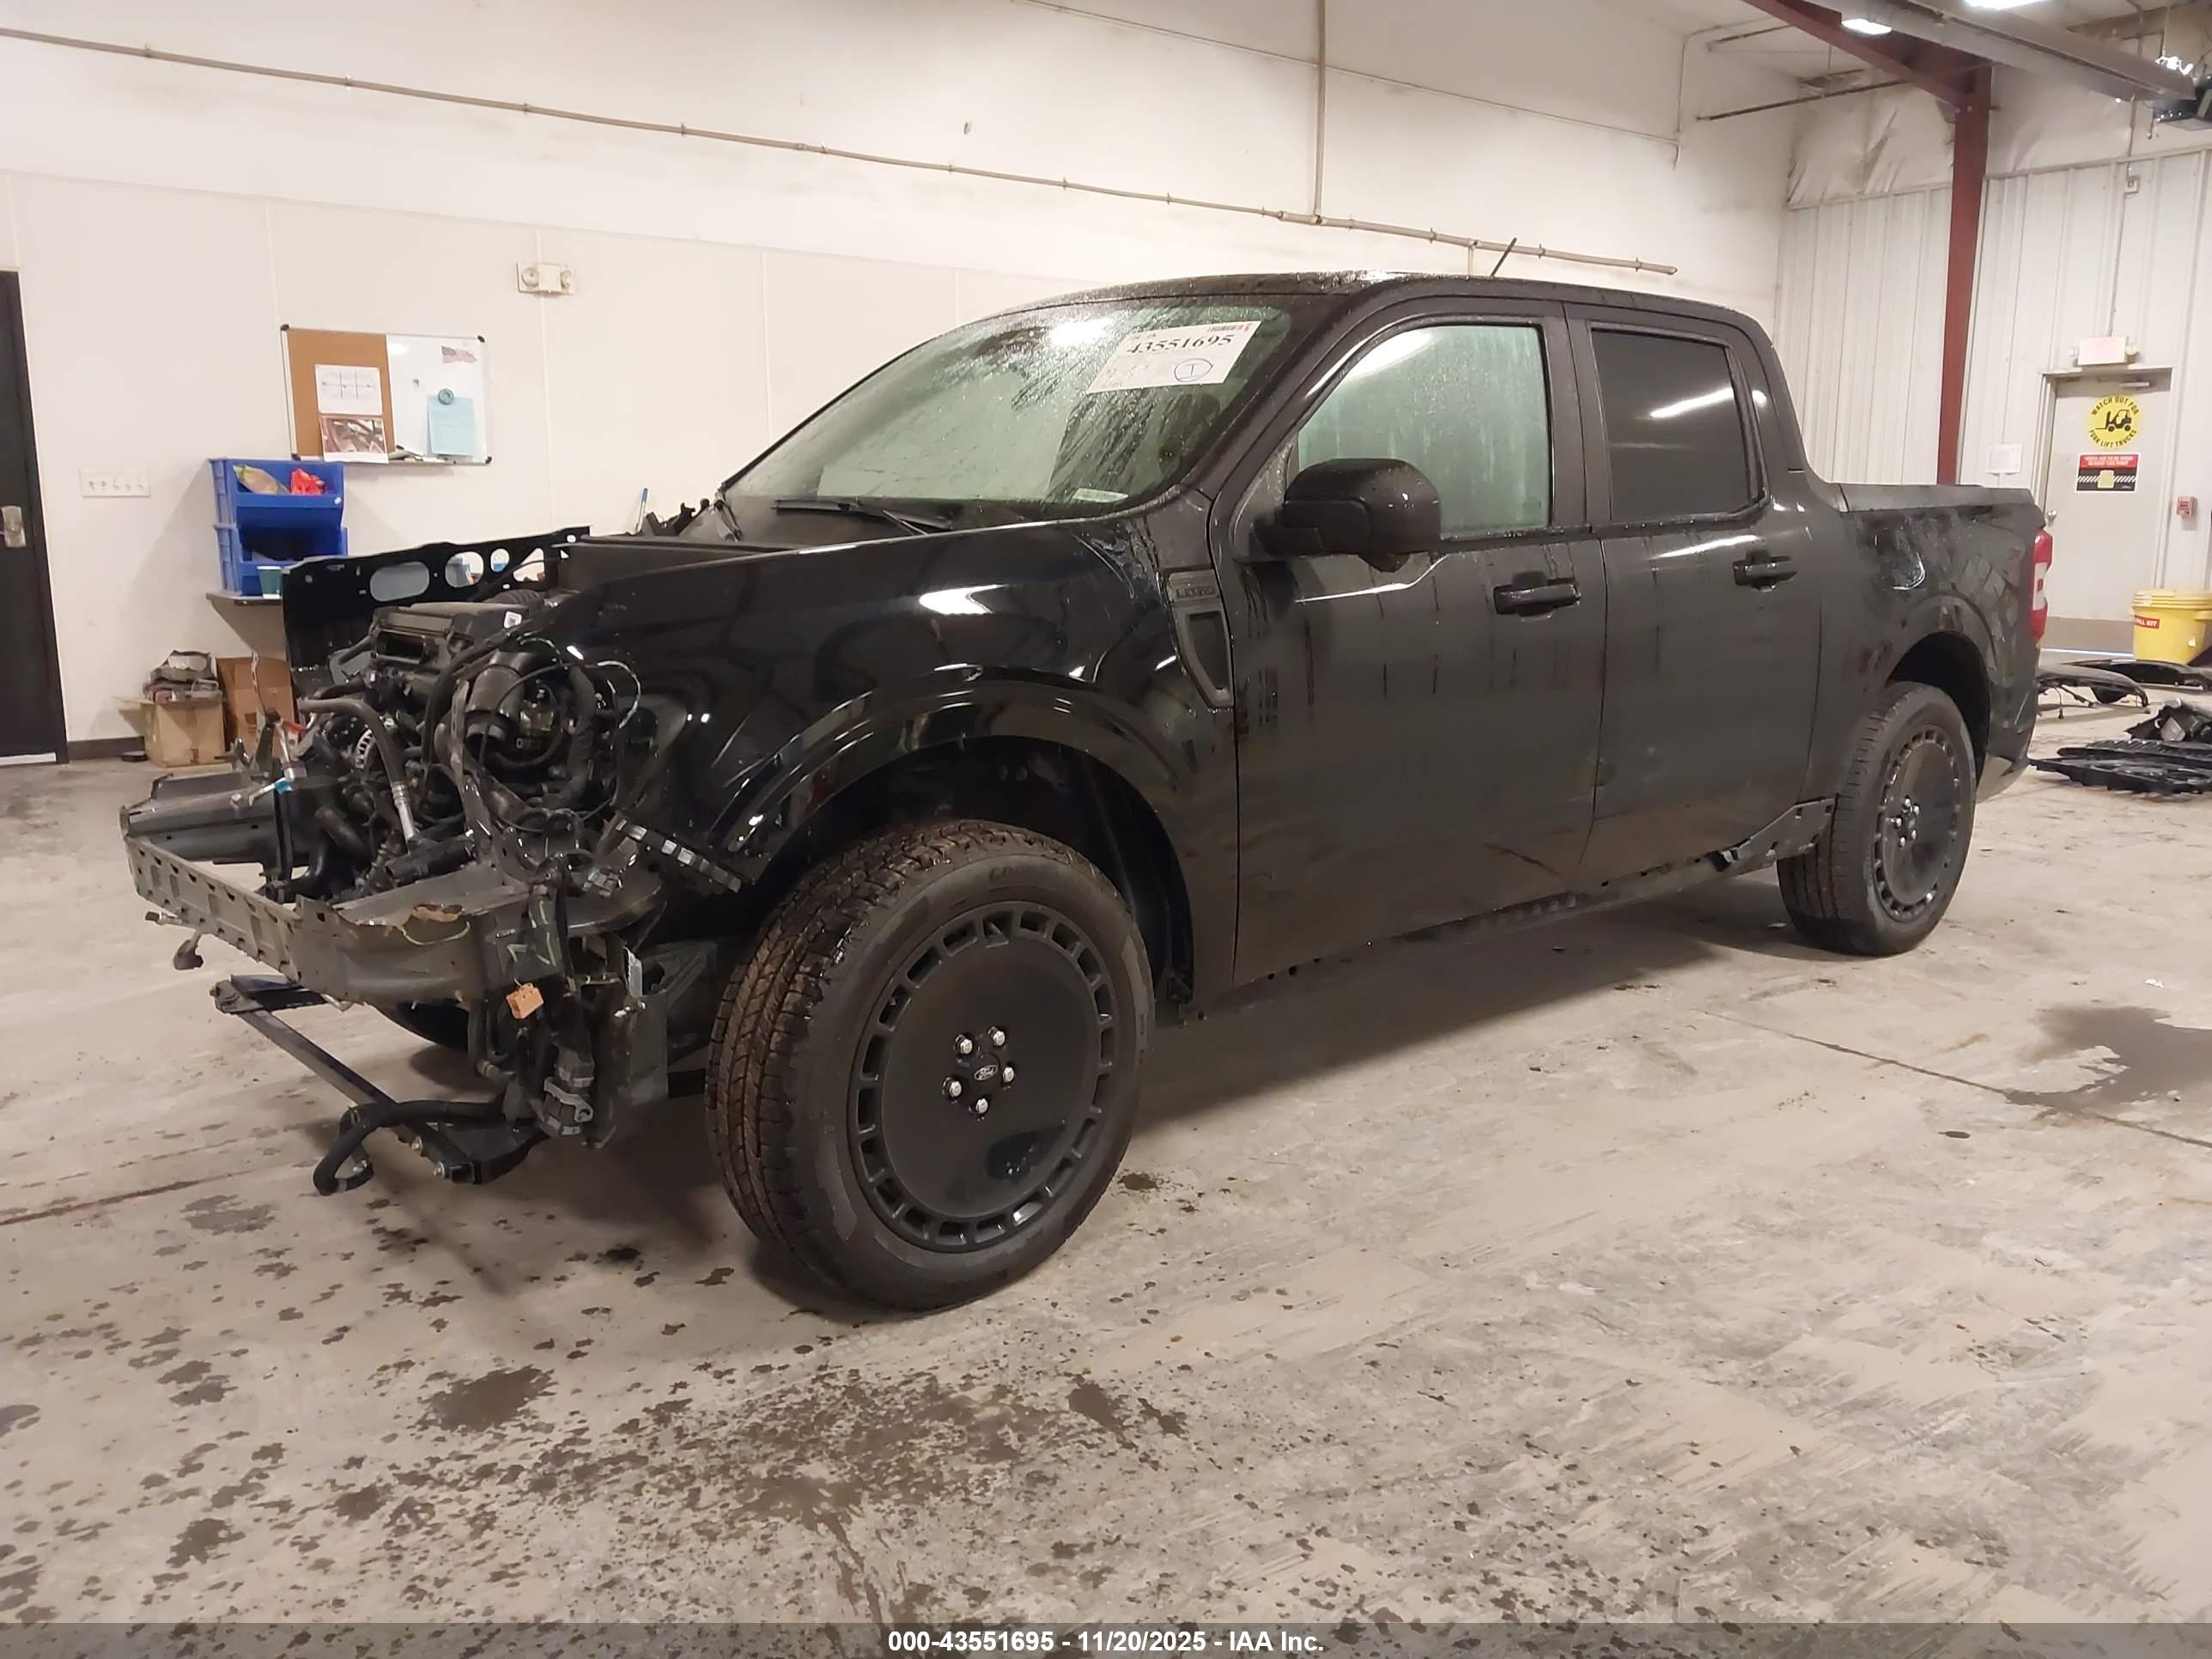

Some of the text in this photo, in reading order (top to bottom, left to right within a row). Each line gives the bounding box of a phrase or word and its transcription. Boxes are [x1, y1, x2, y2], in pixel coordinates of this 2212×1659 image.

[1127, 334, 1235, 354] 43551695
[2091, 397, 2113, 416] WATCH
[2128, 401, 2140, 415] FOR
[2116, 429, 2137, 447] TRUCKS
